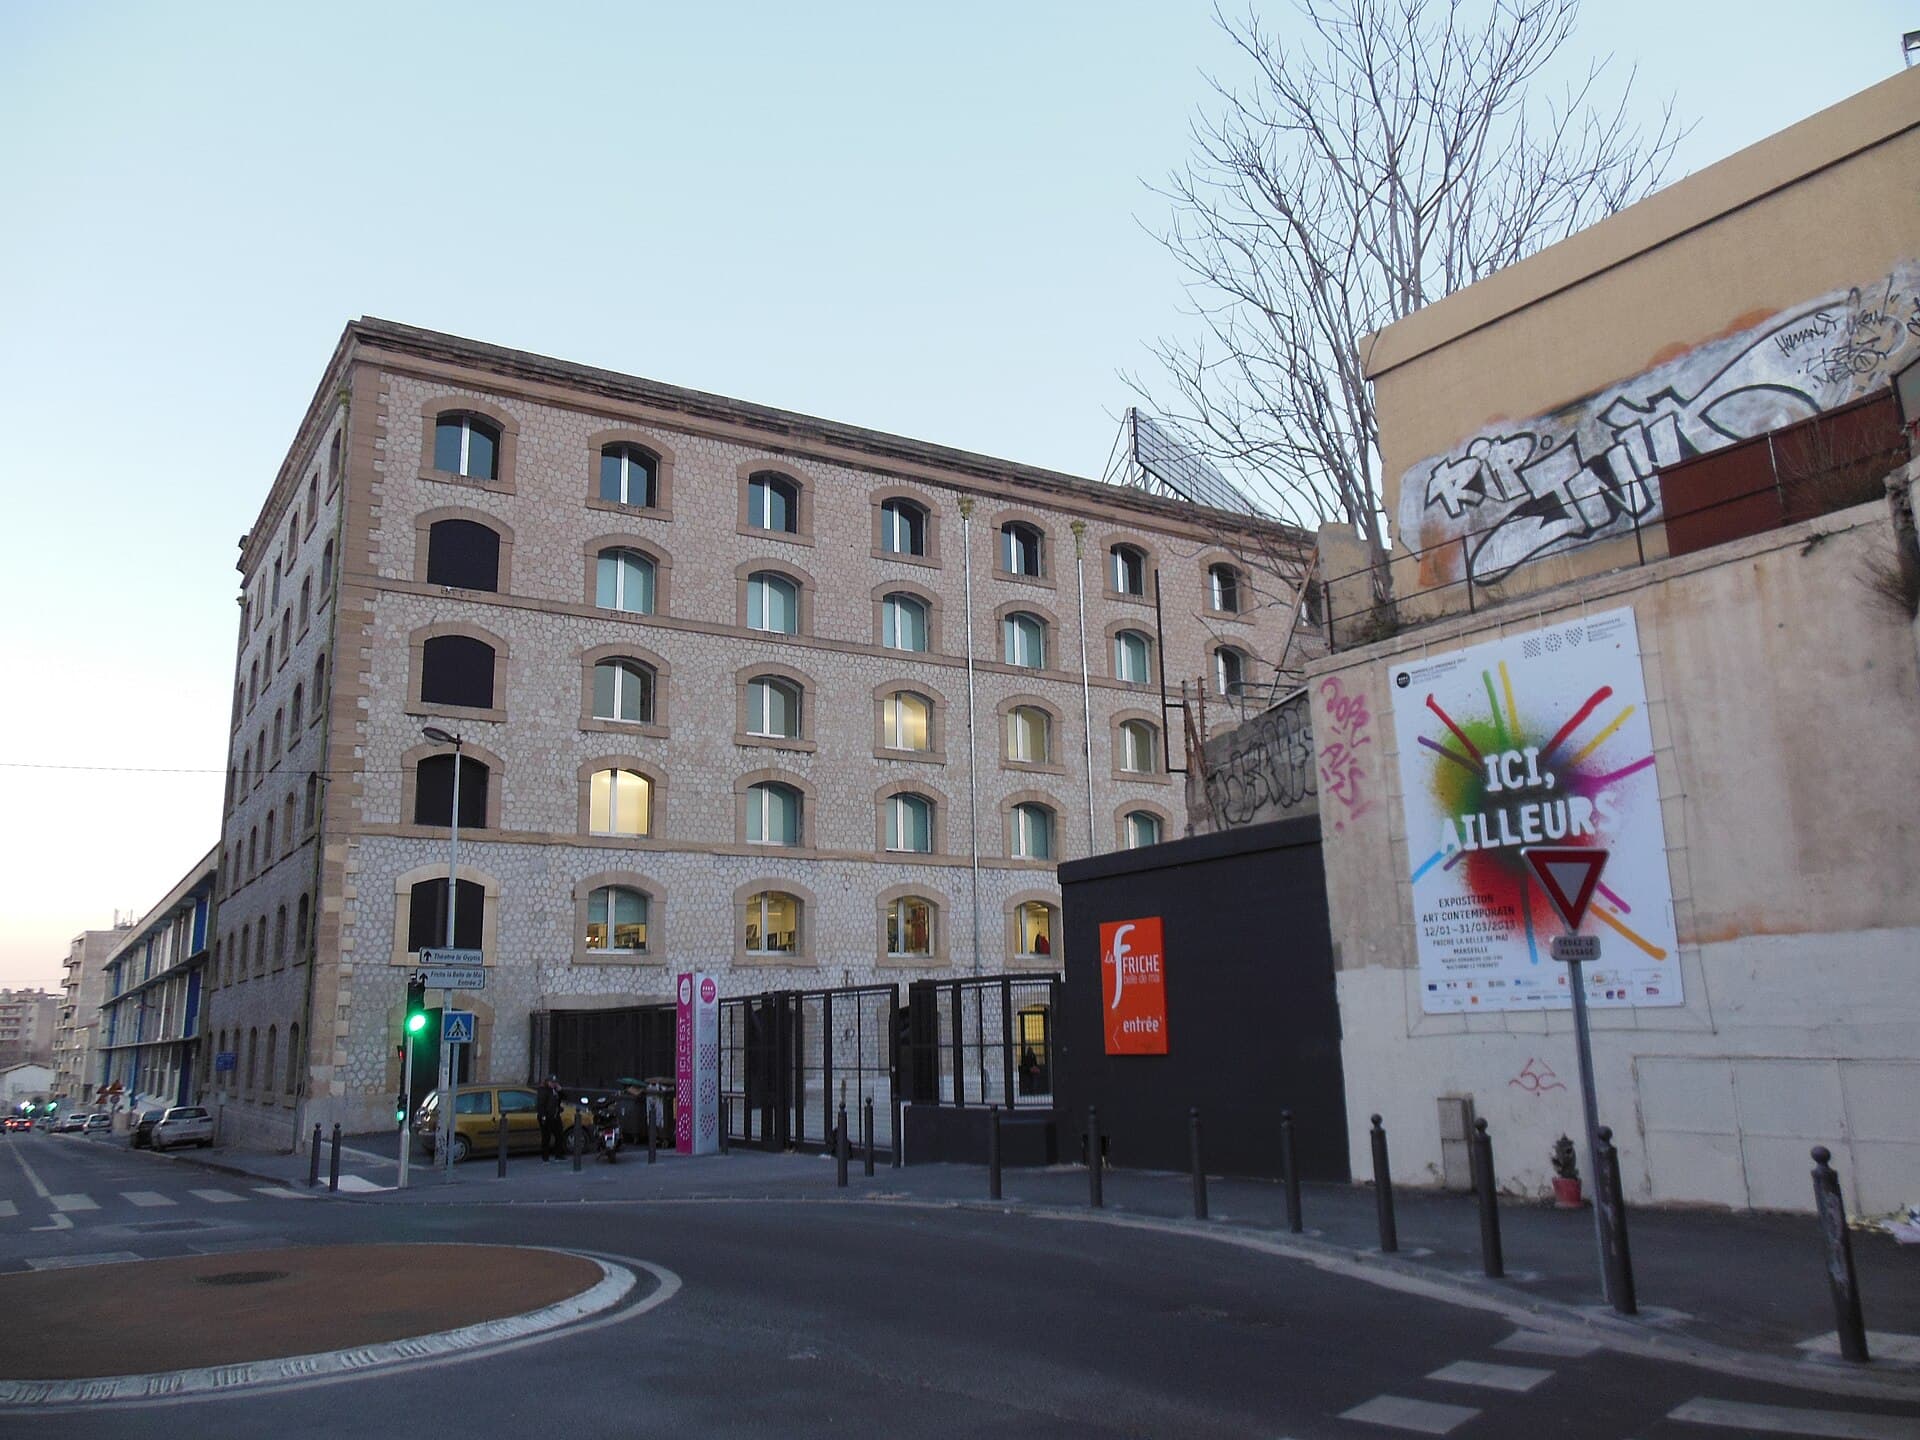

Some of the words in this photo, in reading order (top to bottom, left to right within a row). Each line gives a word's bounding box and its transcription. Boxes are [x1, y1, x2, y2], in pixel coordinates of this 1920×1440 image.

[1484, 746, 1556, 793] ICI,
[1440, 790, 1620, 855] AILLEURS
[1438, 894, 1494, 909] EXPOSITION
[1423, 913, 1439, 923] ART
[1441, 905, 1515, 922] CONTEMPORAIN
[1122, 954, 1160, 973] FRICHE
[1122, 1015, 1160, 1033] entrée
